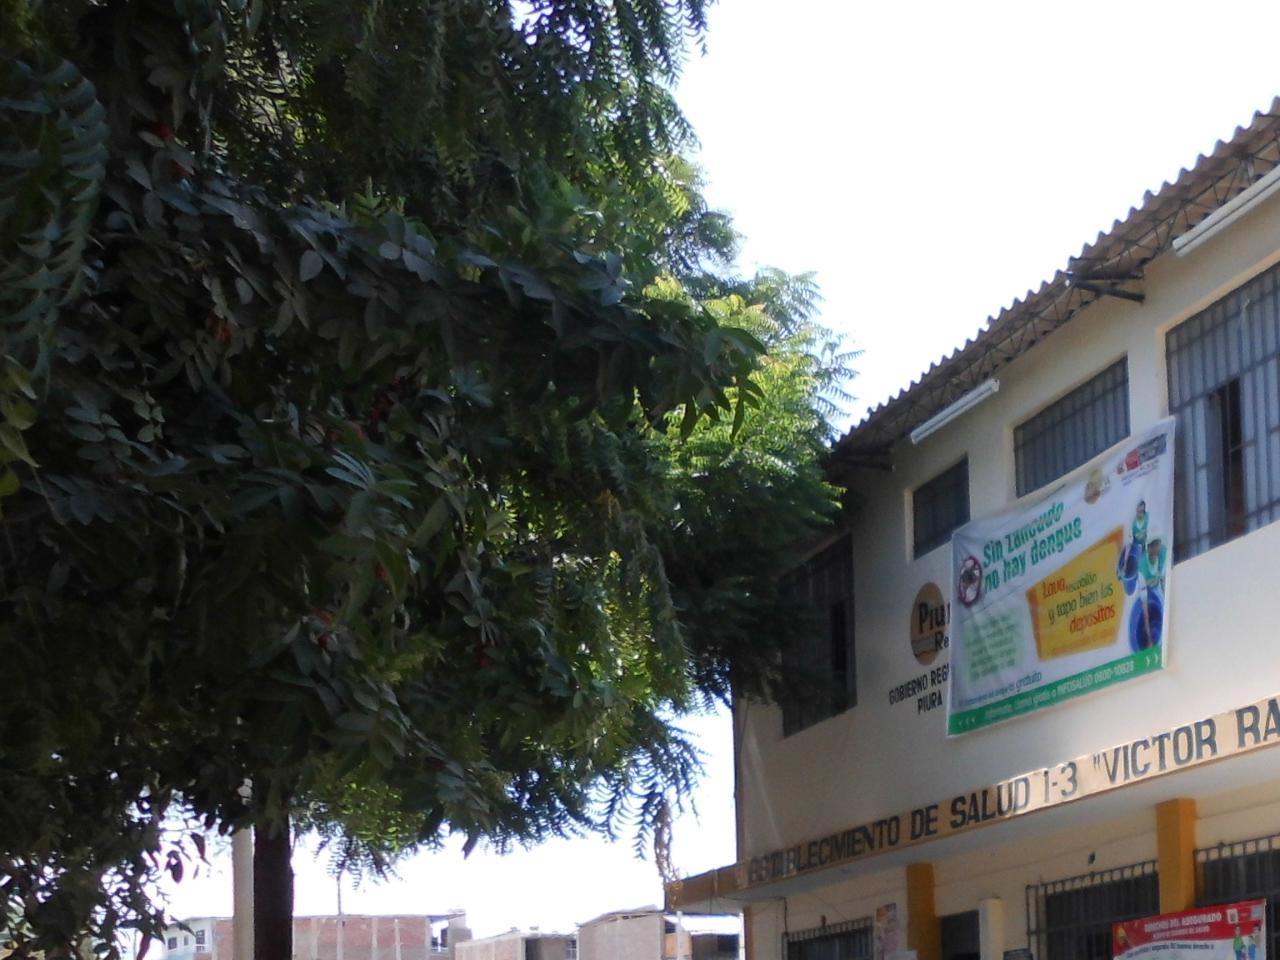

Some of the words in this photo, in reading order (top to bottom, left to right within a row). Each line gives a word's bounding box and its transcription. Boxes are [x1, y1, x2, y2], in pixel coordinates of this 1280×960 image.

[983, 539, 1004, 569] Sin
[984, 569, 1000, 594] no
[1003, 550, 1026, 583] hay
[1030, 517, 1083, 566] dengue
[1048, 607, 1056, 625] y
[1056, 598, 1078, 619] tapa
[1079, 589, 1099, 609] bien
[888, 673, 929, 707] GOBIERNO
[917, 689, 943, 714] PIURA
[910, 804, 939, 841] DE
[950, 776, 1031, 829] SALUD
[1092, 717, 1219, 785] "VICTOR
